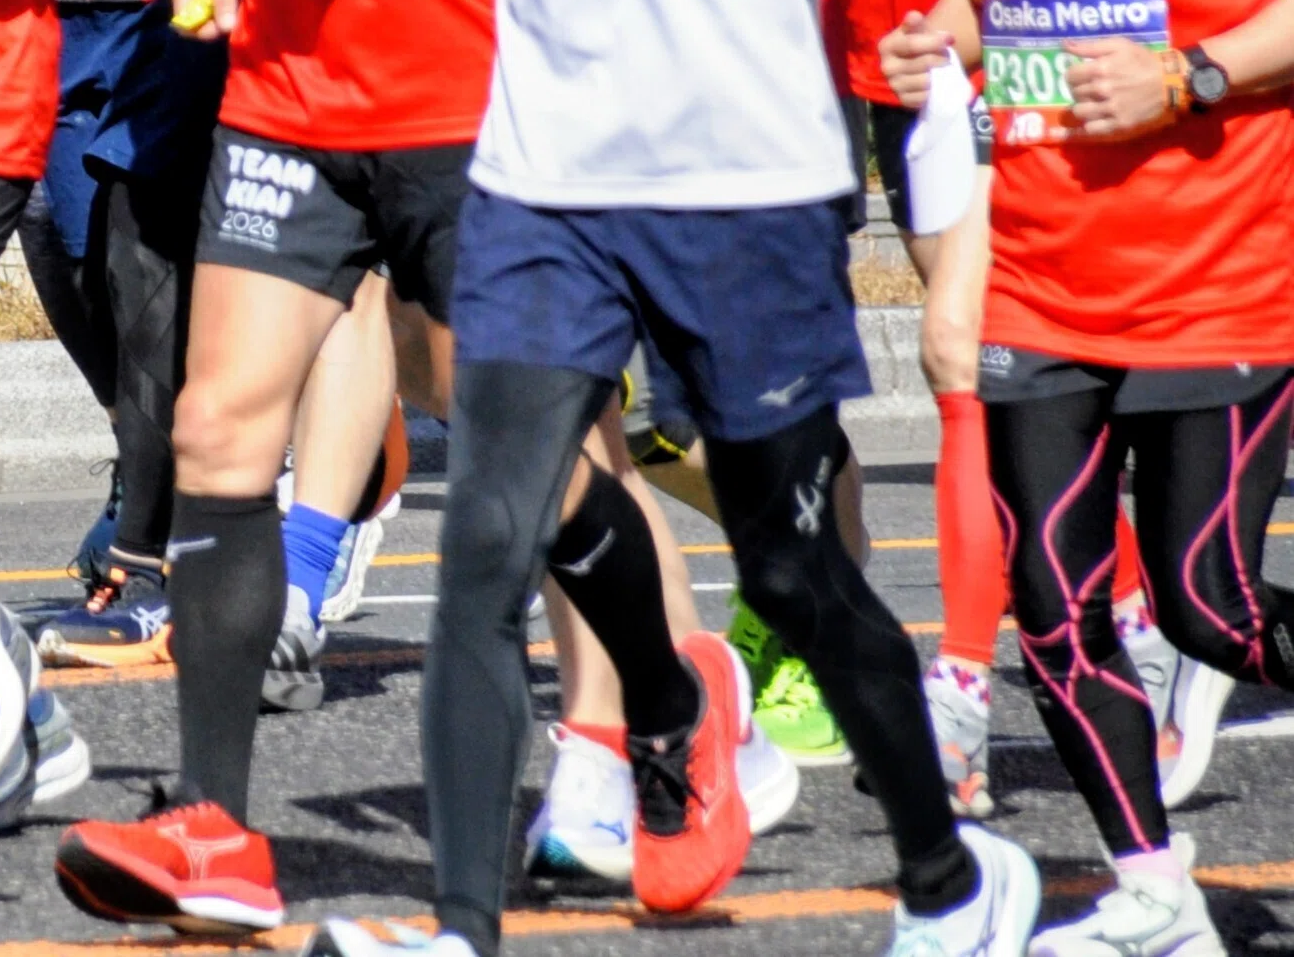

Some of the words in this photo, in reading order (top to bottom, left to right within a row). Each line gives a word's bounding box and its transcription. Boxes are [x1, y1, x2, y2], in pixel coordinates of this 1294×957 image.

[990, 0, 1052, 28] Osaka
[1055, 0, 1150, 28] Metro
[227, 145, 316, 195] TEAM
[224, 178, 293, 219] KIAI
[221, 210, 278, 238] 2026
